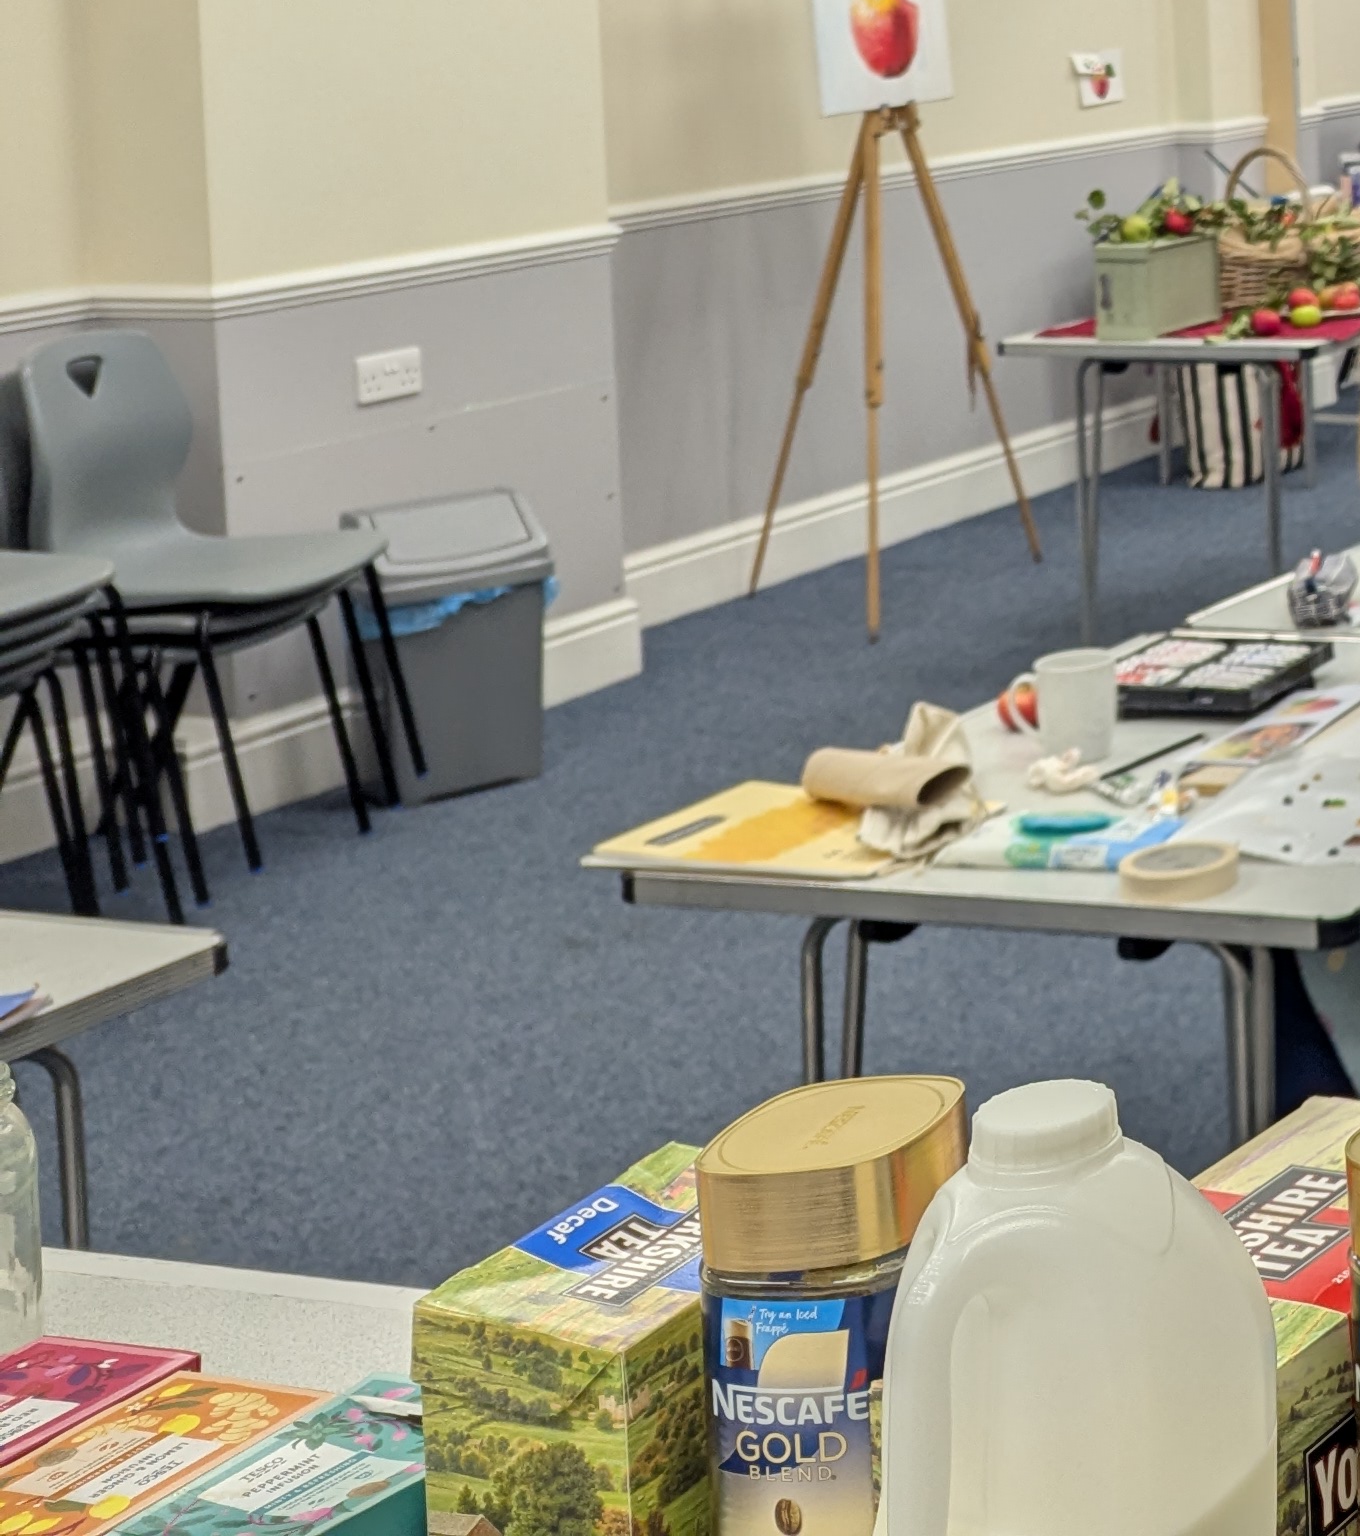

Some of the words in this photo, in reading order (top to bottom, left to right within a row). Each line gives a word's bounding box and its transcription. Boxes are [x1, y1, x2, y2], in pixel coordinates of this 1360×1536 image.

[547, 1197, 620, 1245] Decaf
[575, 1210, 701, 1301] RKSHIRE
[590, 1221, 667, 1260] TEA
[1251, 1227, 1340, 1272] TEA
[755, 1321, 789, 1336] Frappé
[759, 1308, 777, 1322] Try
[779, 1310, 792, 1320] an
[796, 1306, 819, 1321] Iced
[712, 1369, 870, 1426] NESCAFÉ
[147, 1441, 190, 1466] LEMON
[736, 1430, 849, 1464] GOLD
[101, 1452, 157, 1484] INFUSION
[134, 1459, 184, 1487] TESCO
[238, 1456, 288, 1482] TESCO
[242, 1453, 321, 1498] PEPPERMINT
[266, 1464, 320, 1494] INFUSION
[749, 1464, 833, 1482] BLEND
[89, 1472, 135, 1499] GINGER
